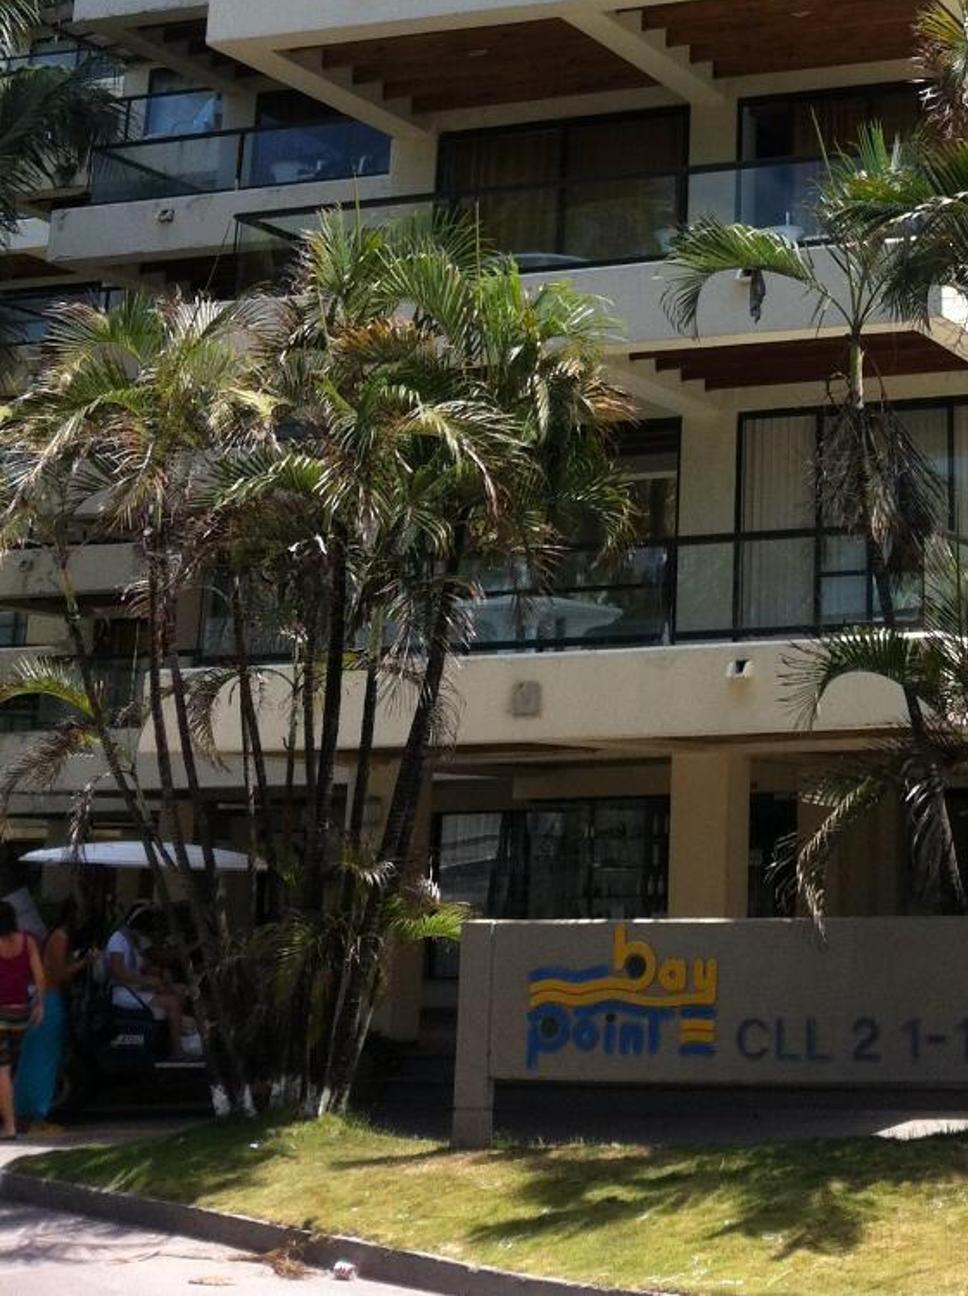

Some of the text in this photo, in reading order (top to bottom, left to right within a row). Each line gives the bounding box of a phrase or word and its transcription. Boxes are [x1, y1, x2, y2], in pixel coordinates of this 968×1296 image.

[612, 923, 717, 1005] bay
[526, 1003, 674, 1071] point
[736, 1017, 835, 1062] CLL
[852, 1017, 882, 1062] 2
